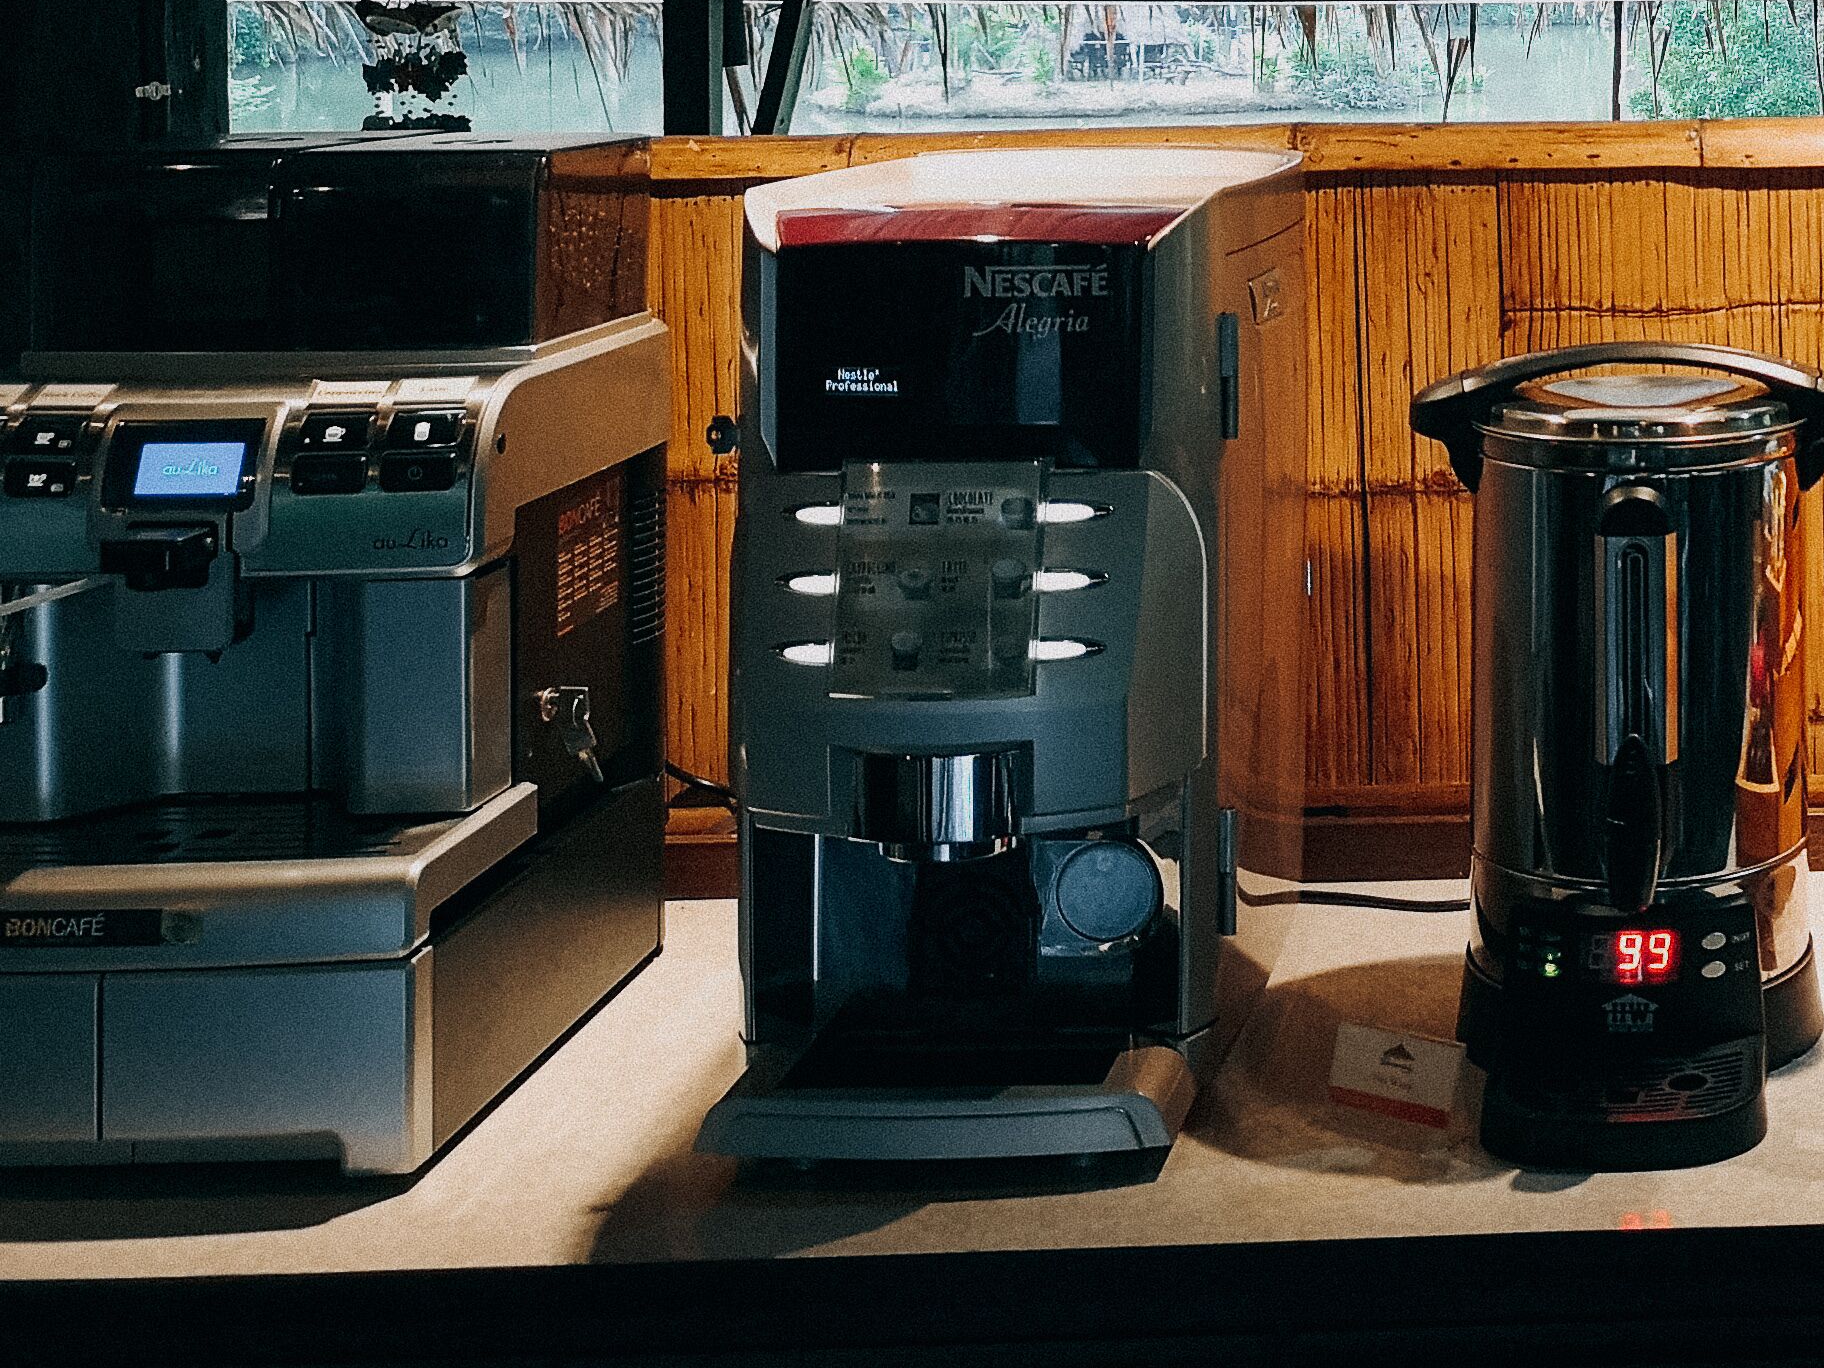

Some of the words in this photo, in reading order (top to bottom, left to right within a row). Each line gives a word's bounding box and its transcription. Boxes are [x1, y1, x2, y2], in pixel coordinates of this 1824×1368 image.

[963, 263, 1109, 298] NESCAFÉ
[972, 302, 1090, 341] Alegria
[825, 380, 898, 393] Professional
[1617, 934, 1670, 971] 99
